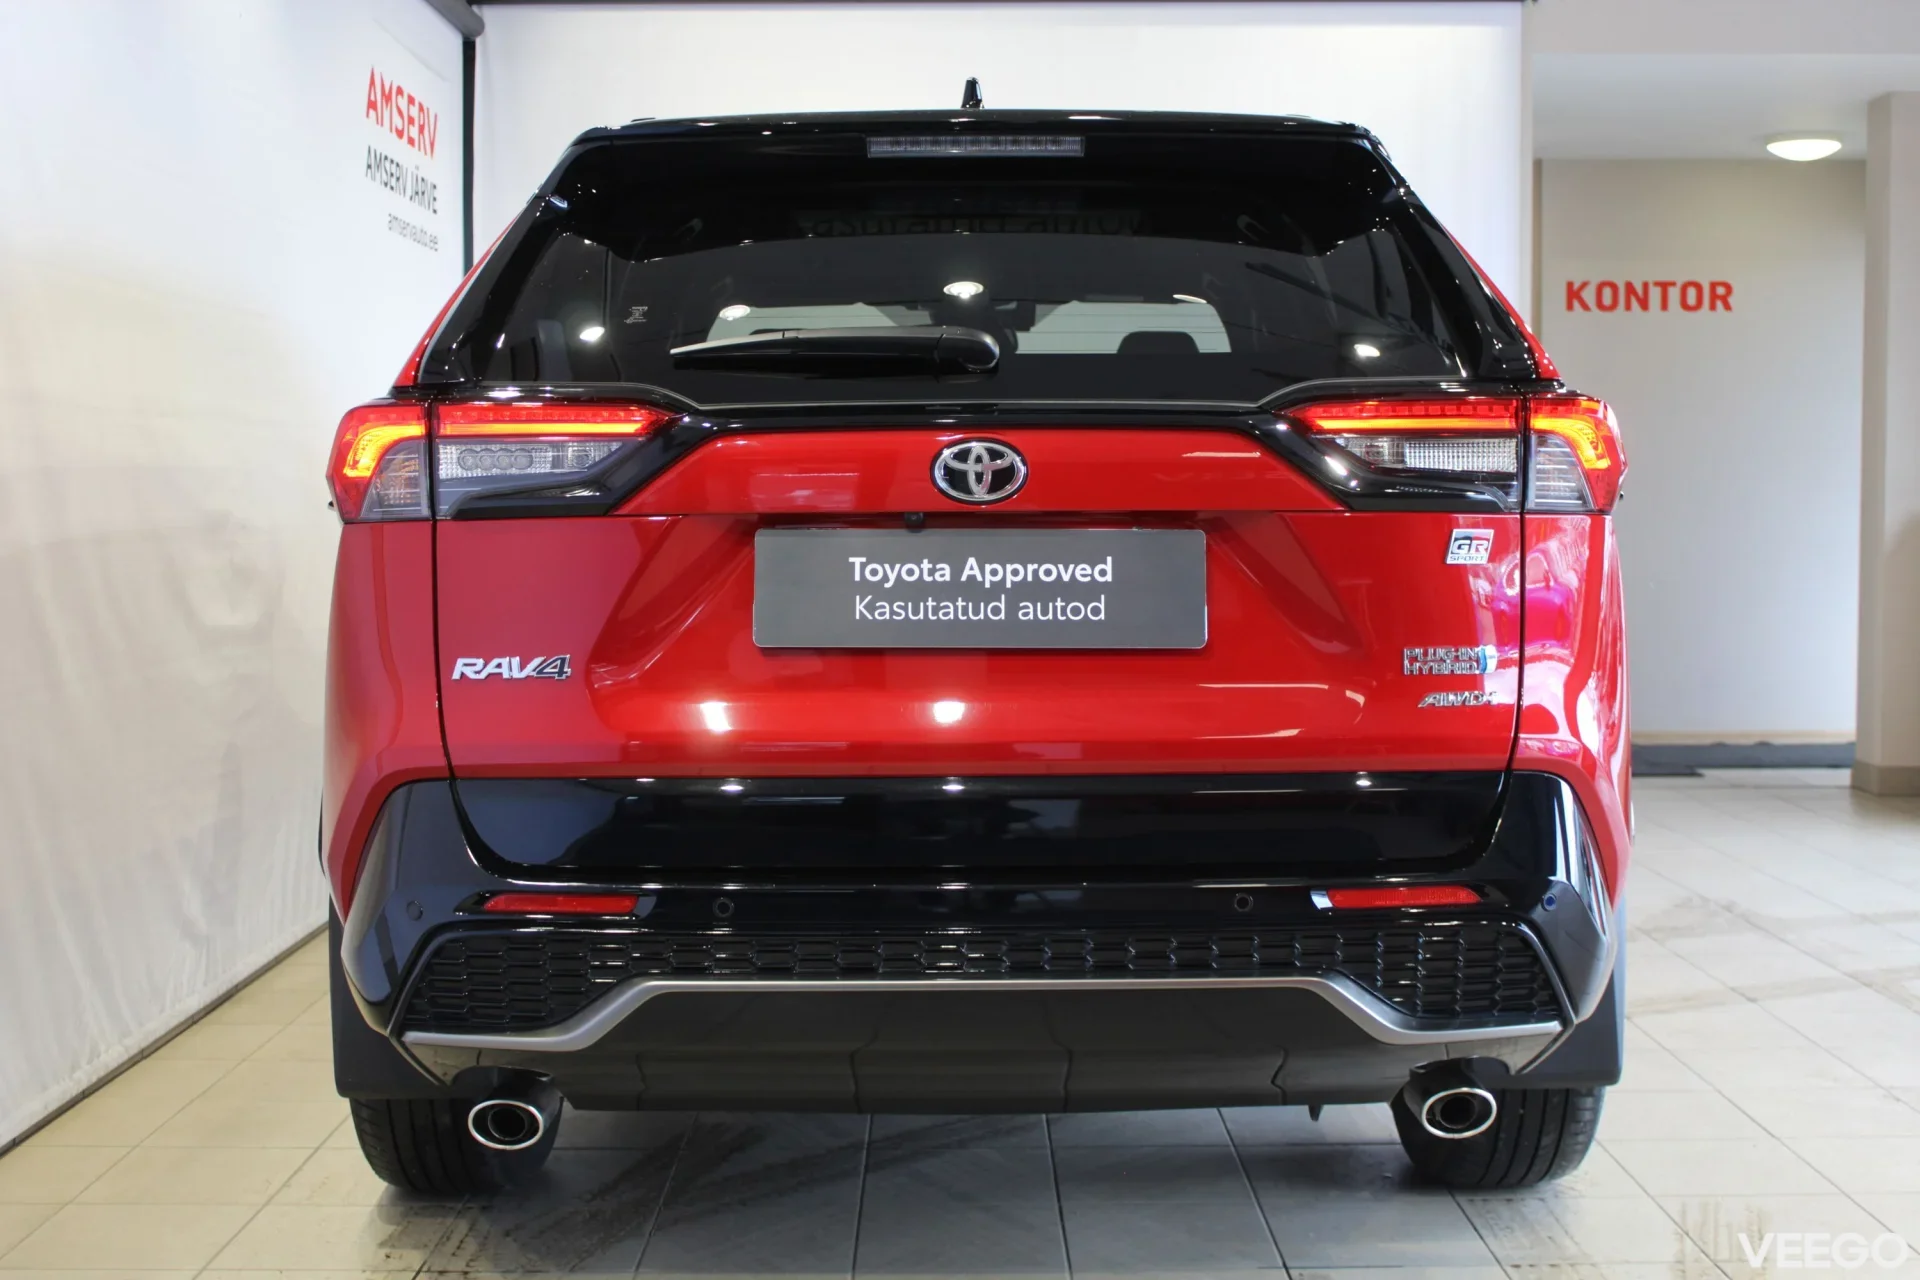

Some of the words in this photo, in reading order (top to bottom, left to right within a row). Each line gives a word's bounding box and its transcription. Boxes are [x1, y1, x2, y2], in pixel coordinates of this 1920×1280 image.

[366, 66, 438, 159] AMSERV
[365, 145, 408, 198] AMSERV
[409, 165, 438, 215] JÄRVE
[387, 212, 439, 252] amservauto.ee
[1565, 280, 1734, 312] KONTOR
[1449, 554, 1486, 563] SPORT
[1452, 539, 1489, 555] GR
[848, 557, 951, 587] Toyota
[961, 556, 1113, 588] Approved
[854, 594, 1006, 620] Kasutatud
[1017, 594, 1106, 620] autod
[451, 654, 572, 681] RAV4
[1403, 647, 1477, 661] PLUG-IN
[1403, 660, 1477, 675] HYBRID
